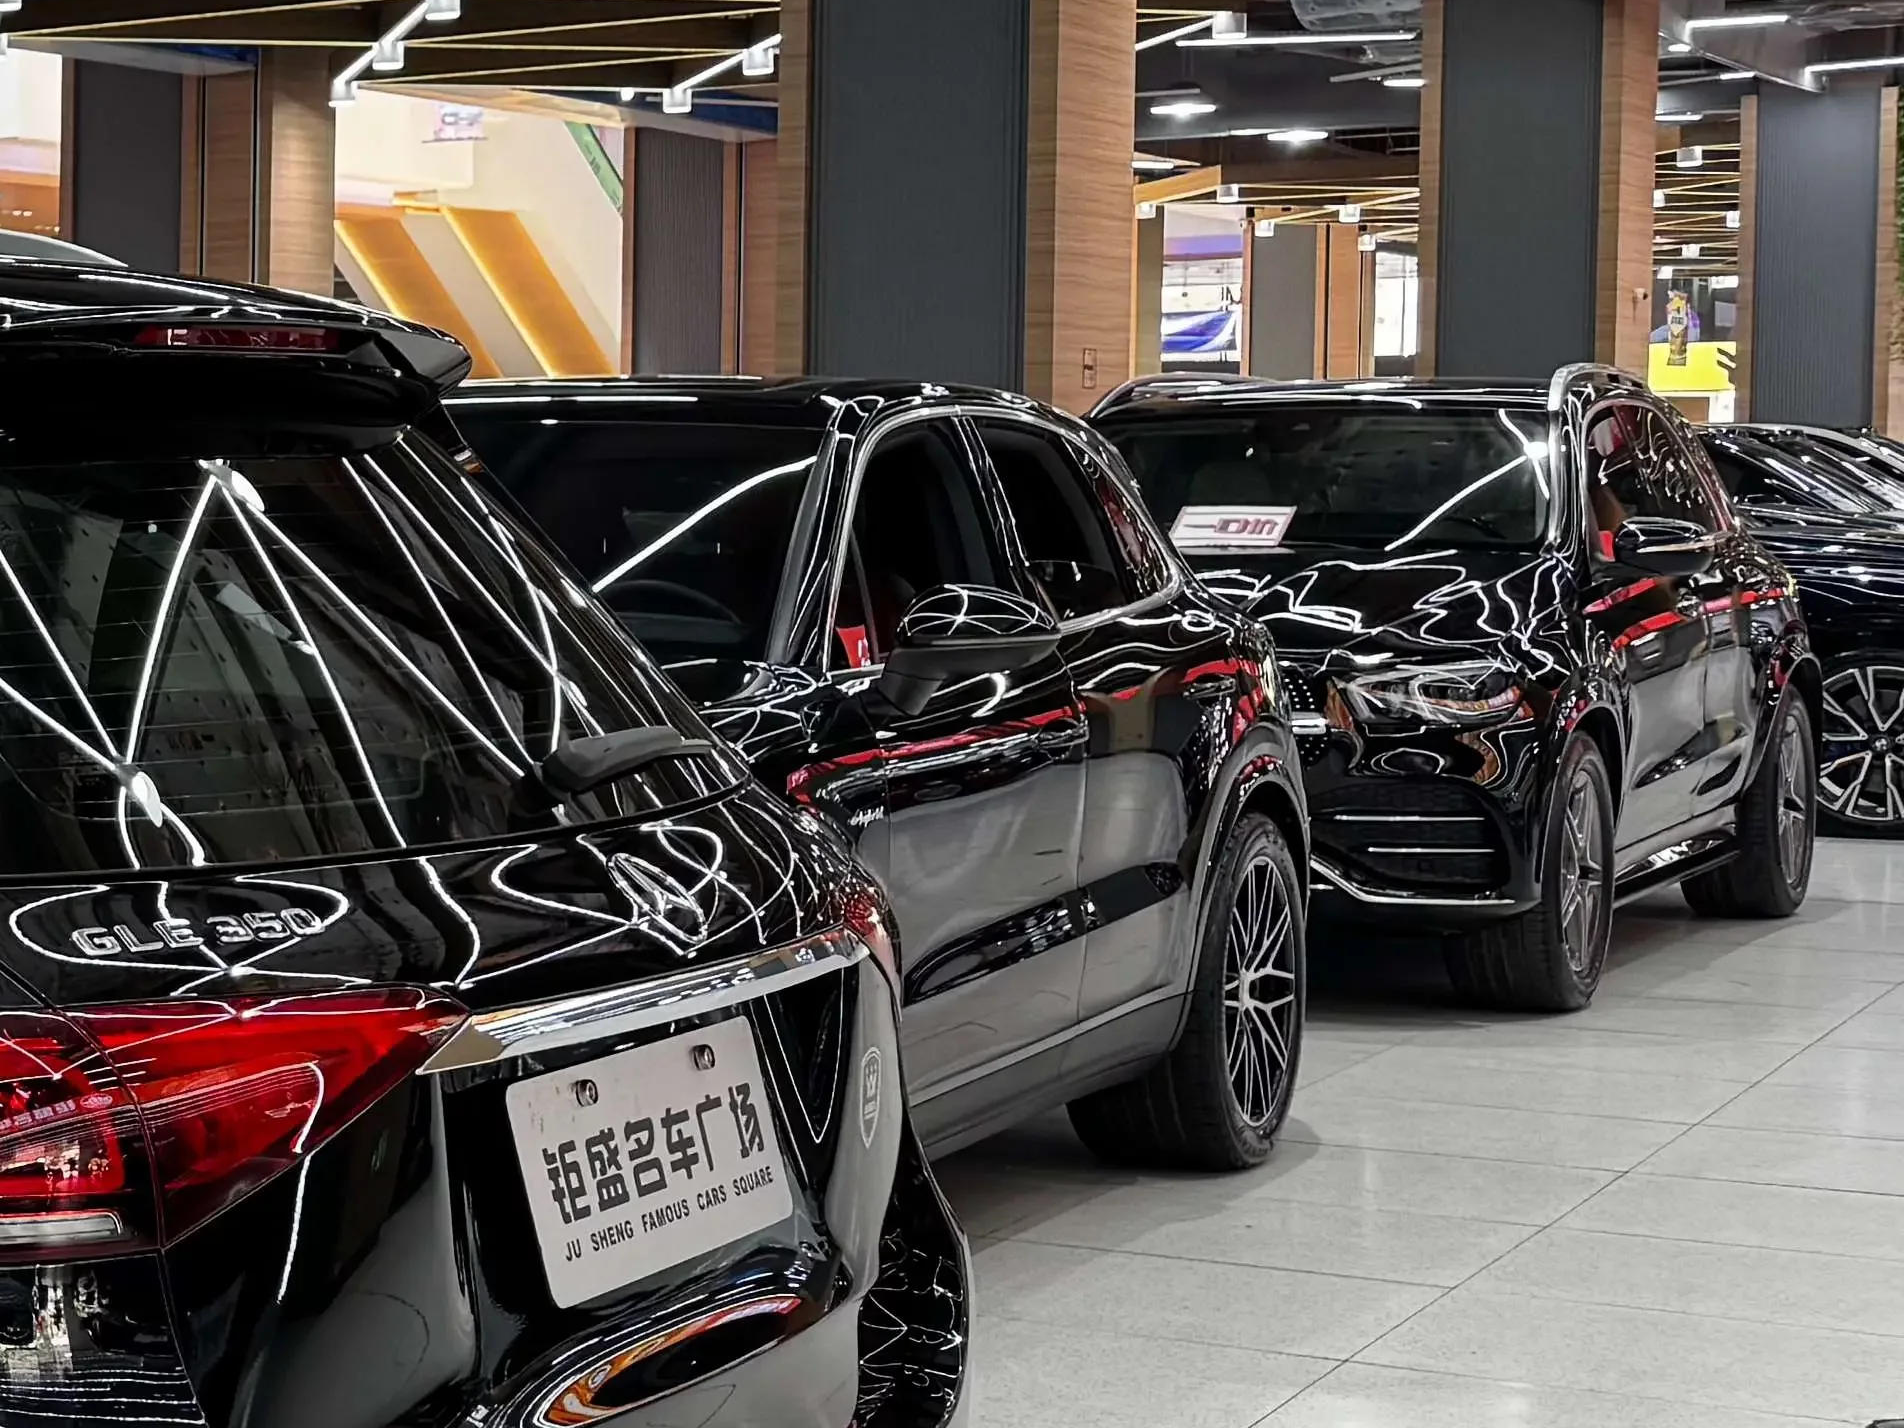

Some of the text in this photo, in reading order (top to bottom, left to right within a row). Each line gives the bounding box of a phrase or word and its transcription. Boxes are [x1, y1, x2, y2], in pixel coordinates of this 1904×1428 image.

[70, 908, 325, 957] GLE 350
[542, 1082, 765, 1225] 钜盛名车广场
[564, 1165, 775, 1262] JU SHENG FAMOUS CARS SQUARE
